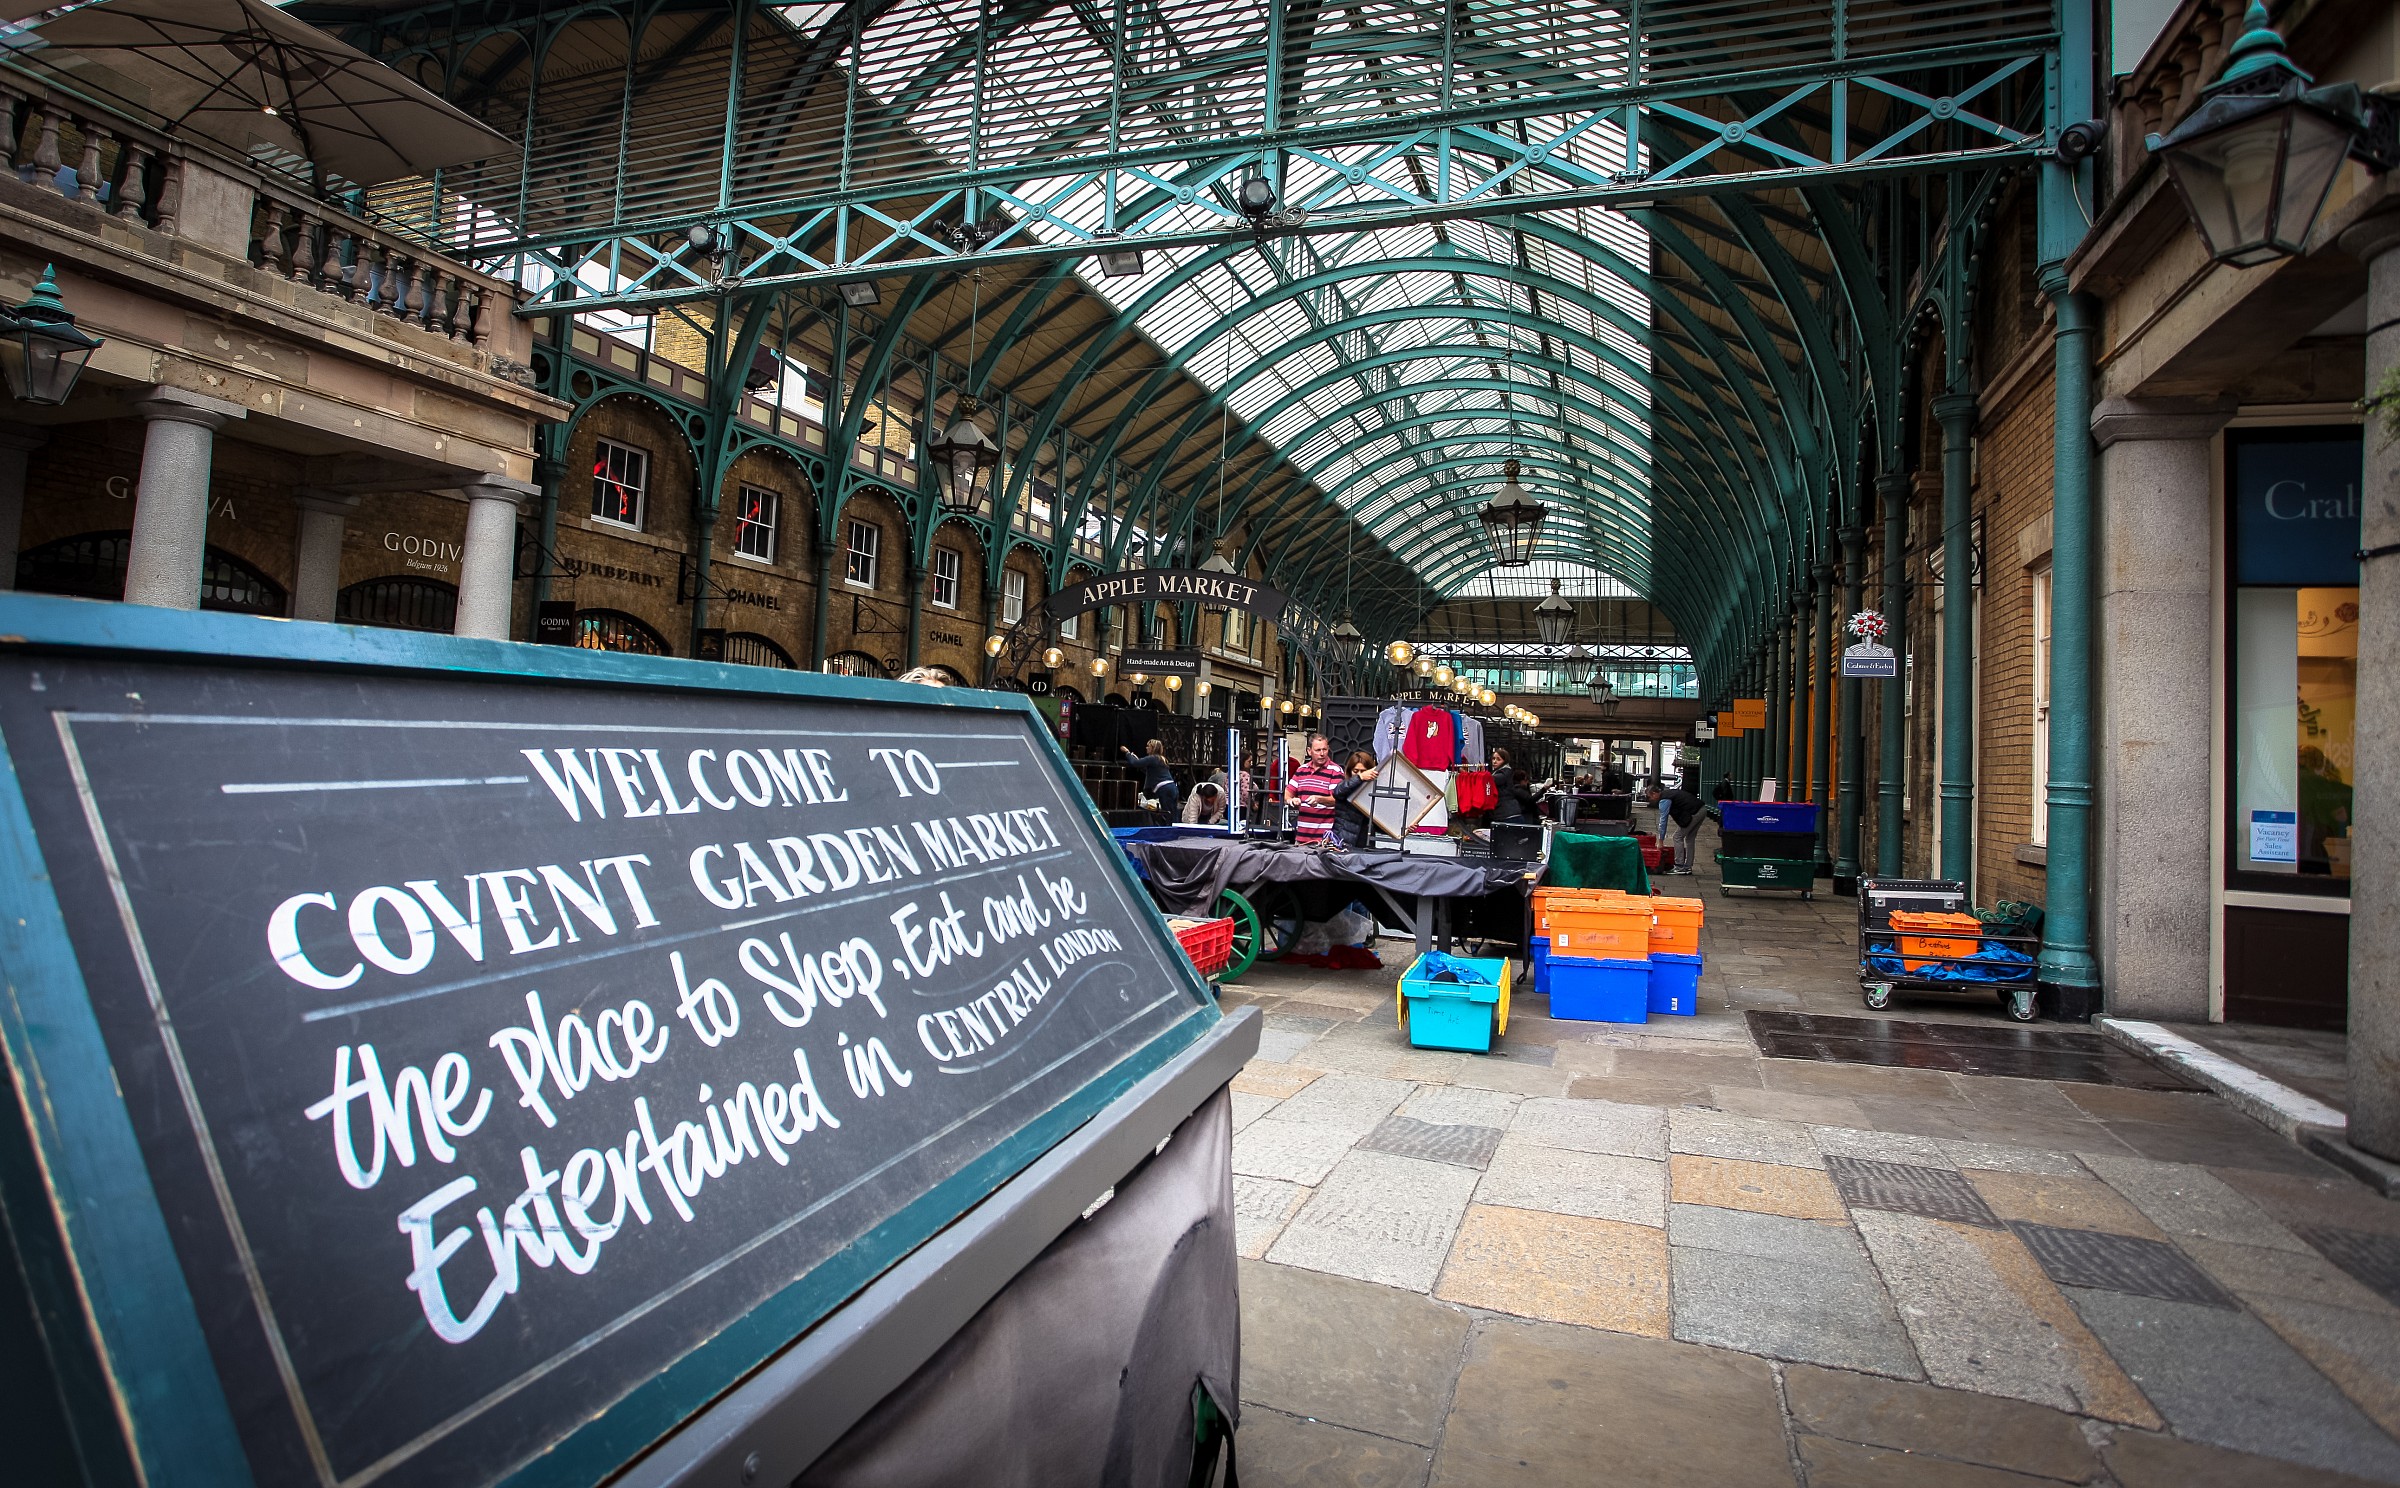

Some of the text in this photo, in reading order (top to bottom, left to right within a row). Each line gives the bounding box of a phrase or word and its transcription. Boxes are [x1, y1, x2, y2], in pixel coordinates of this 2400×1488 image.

[384, 532, 464, 563] GODIV
[406, 558, 448, 573] Belgium 1926
[565, 558, 664, 587] BURBERRY
[728, 588, 781, 611] CHANEL
[1082, 575, 1258, 605] APPLE MARKET
[540, 617, 570, 626] GODIVA
[929, 630, 963, 647] CHANEL
[1126, 658, 1159, 666] Hand-made
[1175, 660, 1195, 668] Design
[1389, 690, 1422, 701] APPLE
[520, 747, 941, 822] WELCOME TO
[2257, 828, 2290, 838] Vacancy
[2258, 848, 2289, 856] Assistant
[2264, 842, 2282, 850] Sales
[267, 806, 1062, 990] COVENT GARDEN MARKET
[305, 1043, 493, 1189] the
[670, 950, 740, 1048] to
[889, 890, 984, 978] Eat
[982, 874, 1051, 944] and
[1034, 866, 1087, 921] be
[399, 928, 1123, 1343] Entertained in CENTRAL LONDON
